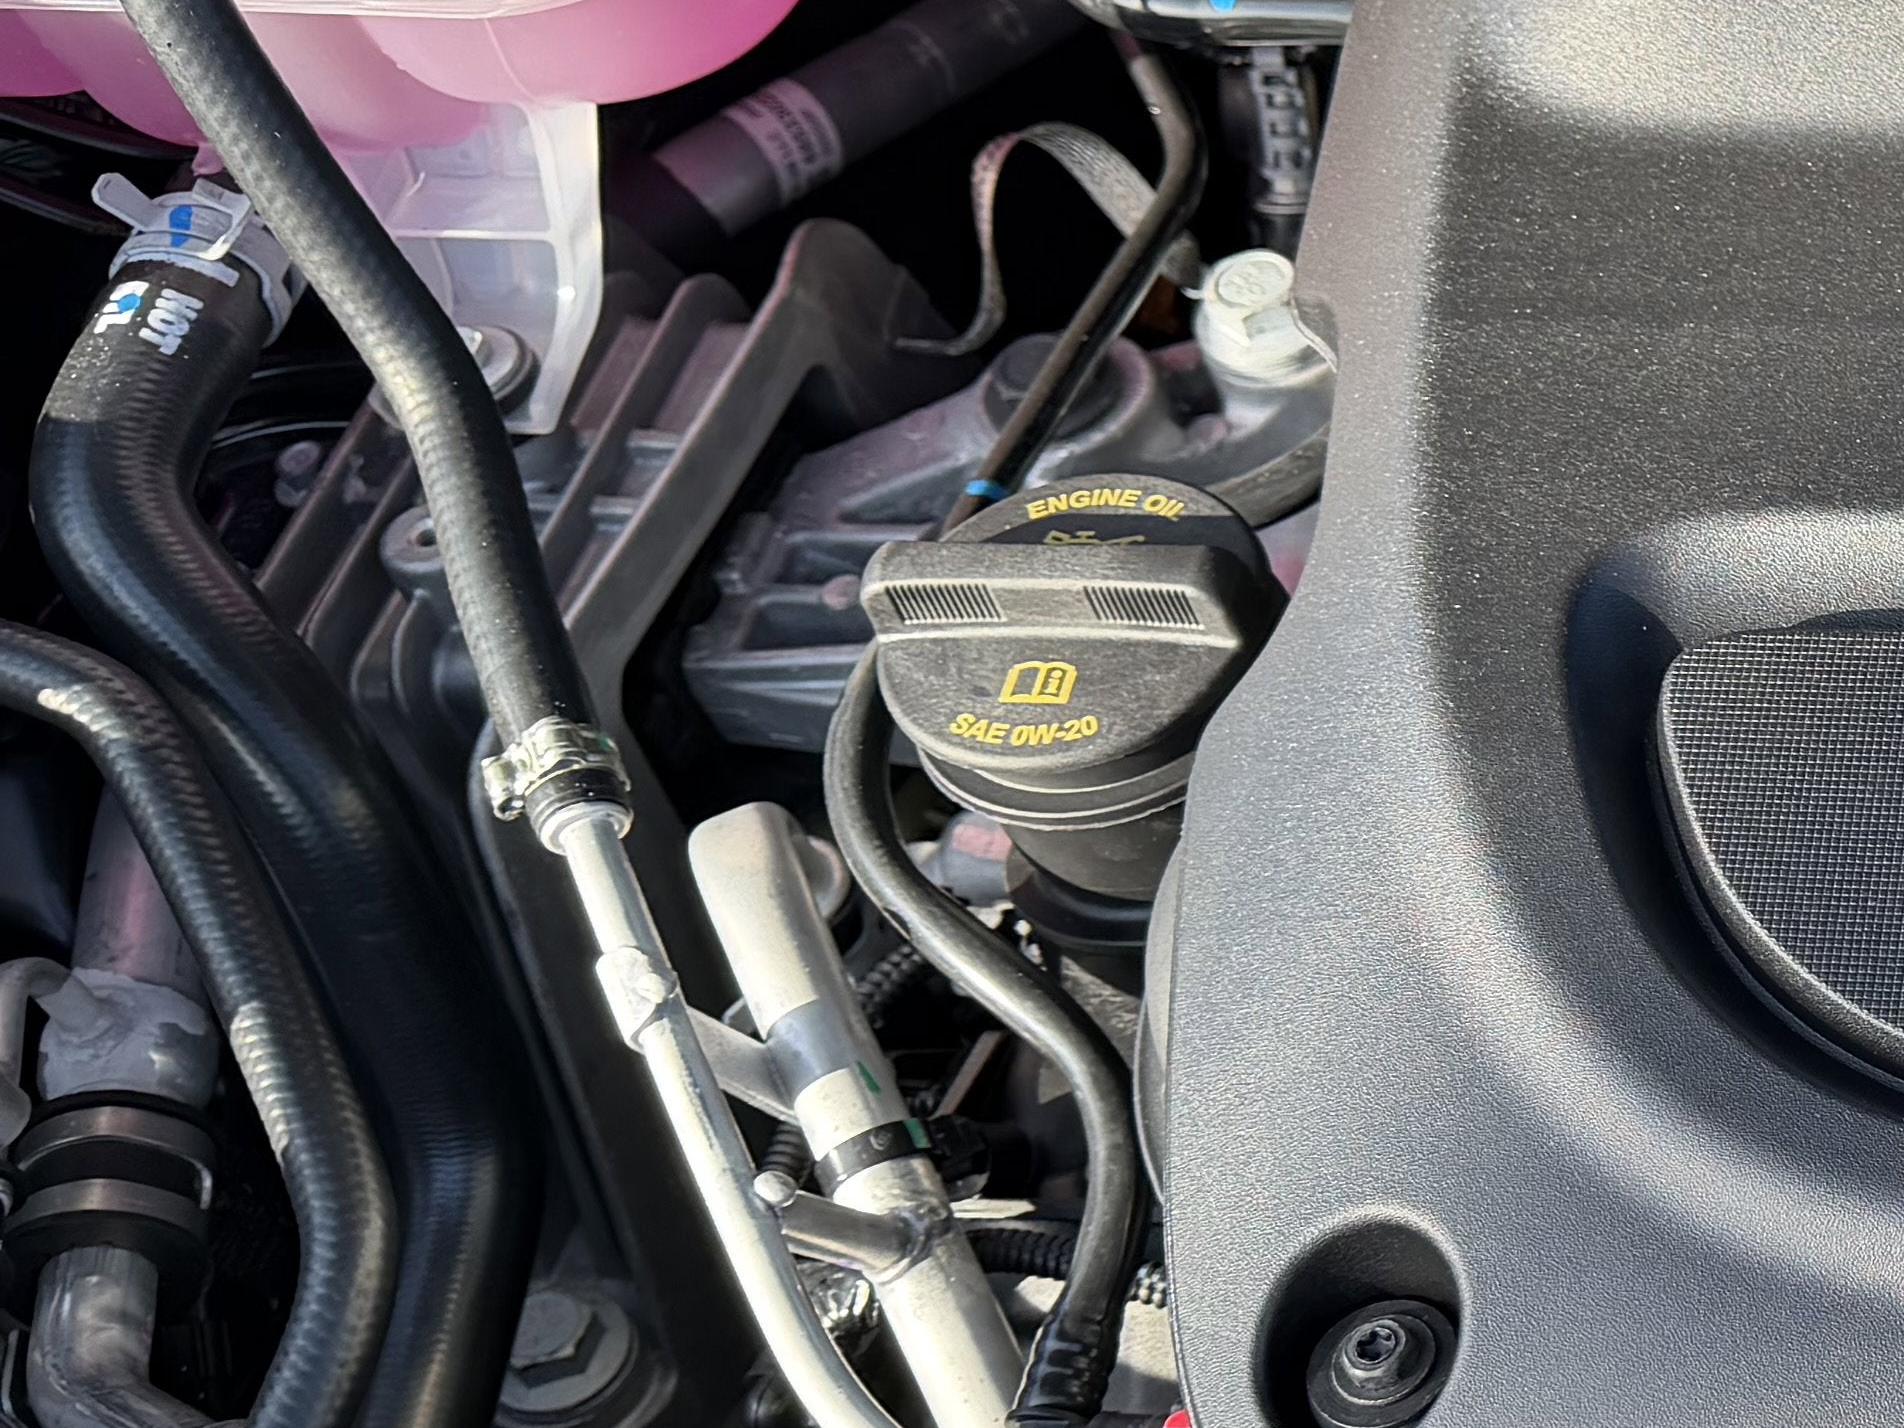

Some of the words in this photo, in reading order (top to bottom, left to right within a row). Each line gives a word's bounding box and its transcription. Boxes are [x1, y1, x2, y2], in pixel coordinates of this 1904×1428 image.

[138, 288, 204, 355] HOT
[1026, 488, 1142, 520] ENGINE
[1143, 494, 1184, 521] OIL
[950, 713, 1010, 744] SAE
[1010, 715, 1099, 746] 0W-20
